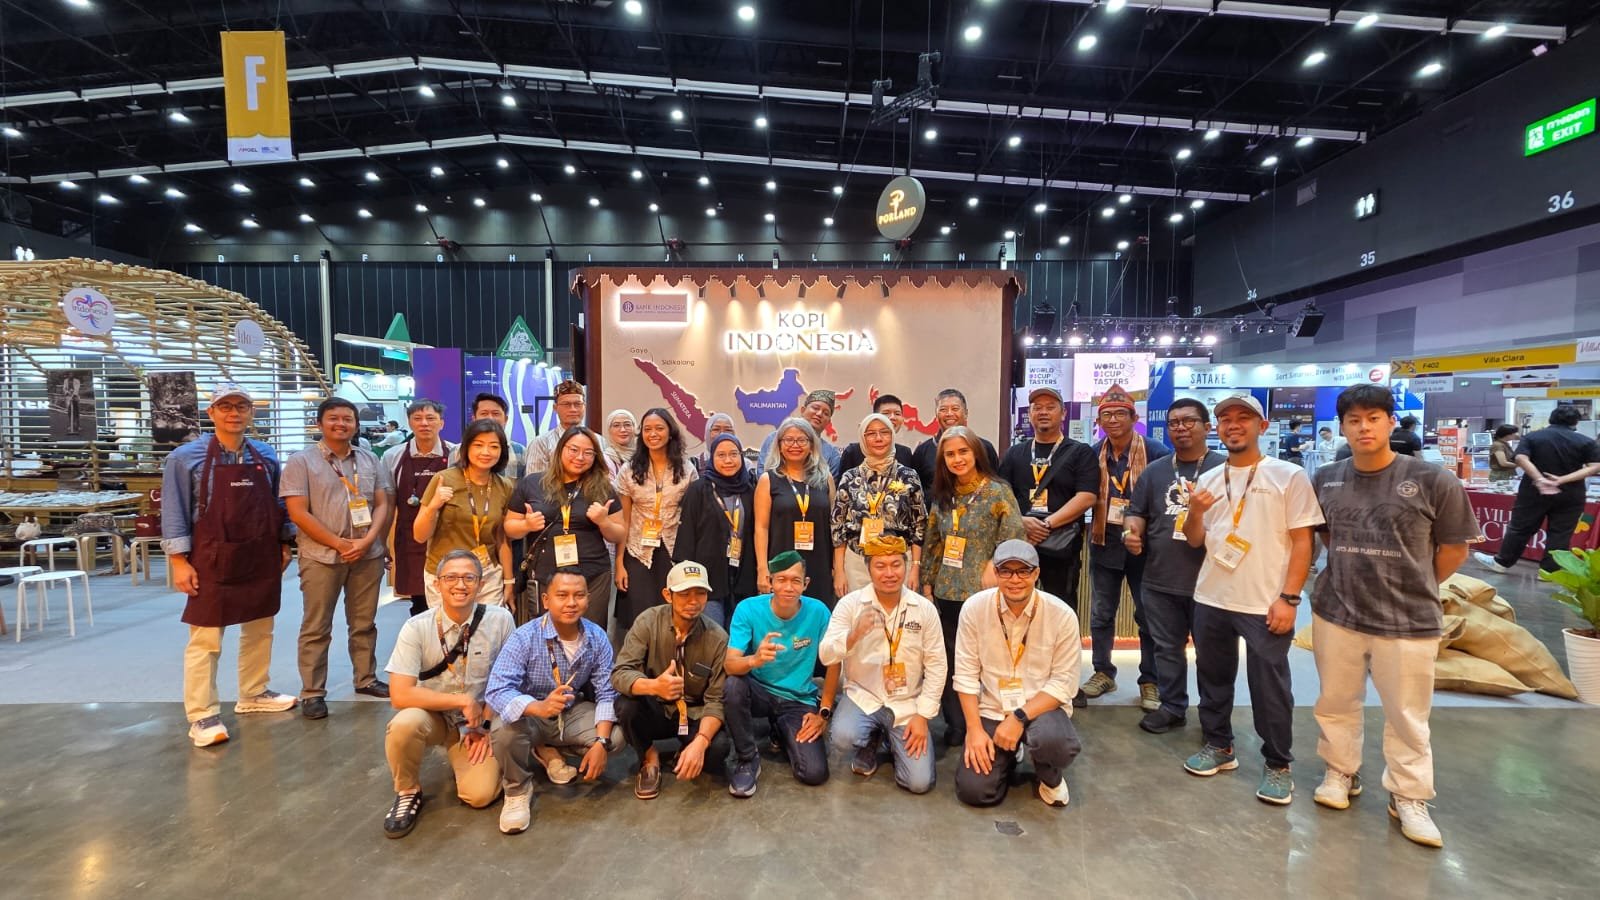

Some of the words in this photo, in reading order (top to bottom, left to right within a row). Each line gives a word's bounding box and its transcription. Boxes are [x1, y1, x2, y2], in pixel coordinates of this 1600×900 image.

[245, 55, 266, 111] F
[1552, 121, 1582, 141] EXIT
[1548, 191, 1574, 213] 36
[1360, 251, 1376, 267] 35
[1247, 289, 1258, 301] 34
[1193, 306, 1202, 316] 33
[778, 312, 825, 328] KOPI
[728, 332, 874, 351] INDONESIA
[630, 347, 649, 355] Gayo
[661, 359, 695, 367] Sidikalang
[1484, 356, 1500, 364] Villa
[1502, 354, 1525, 362] Clara
[1094, 377, 1130, 386] TASTERS
[1190, 373, 1227, 385] SATAKE
[671, 391, 692, 419] SUMATERA
[1484, 507, 1513, 522] VILL
